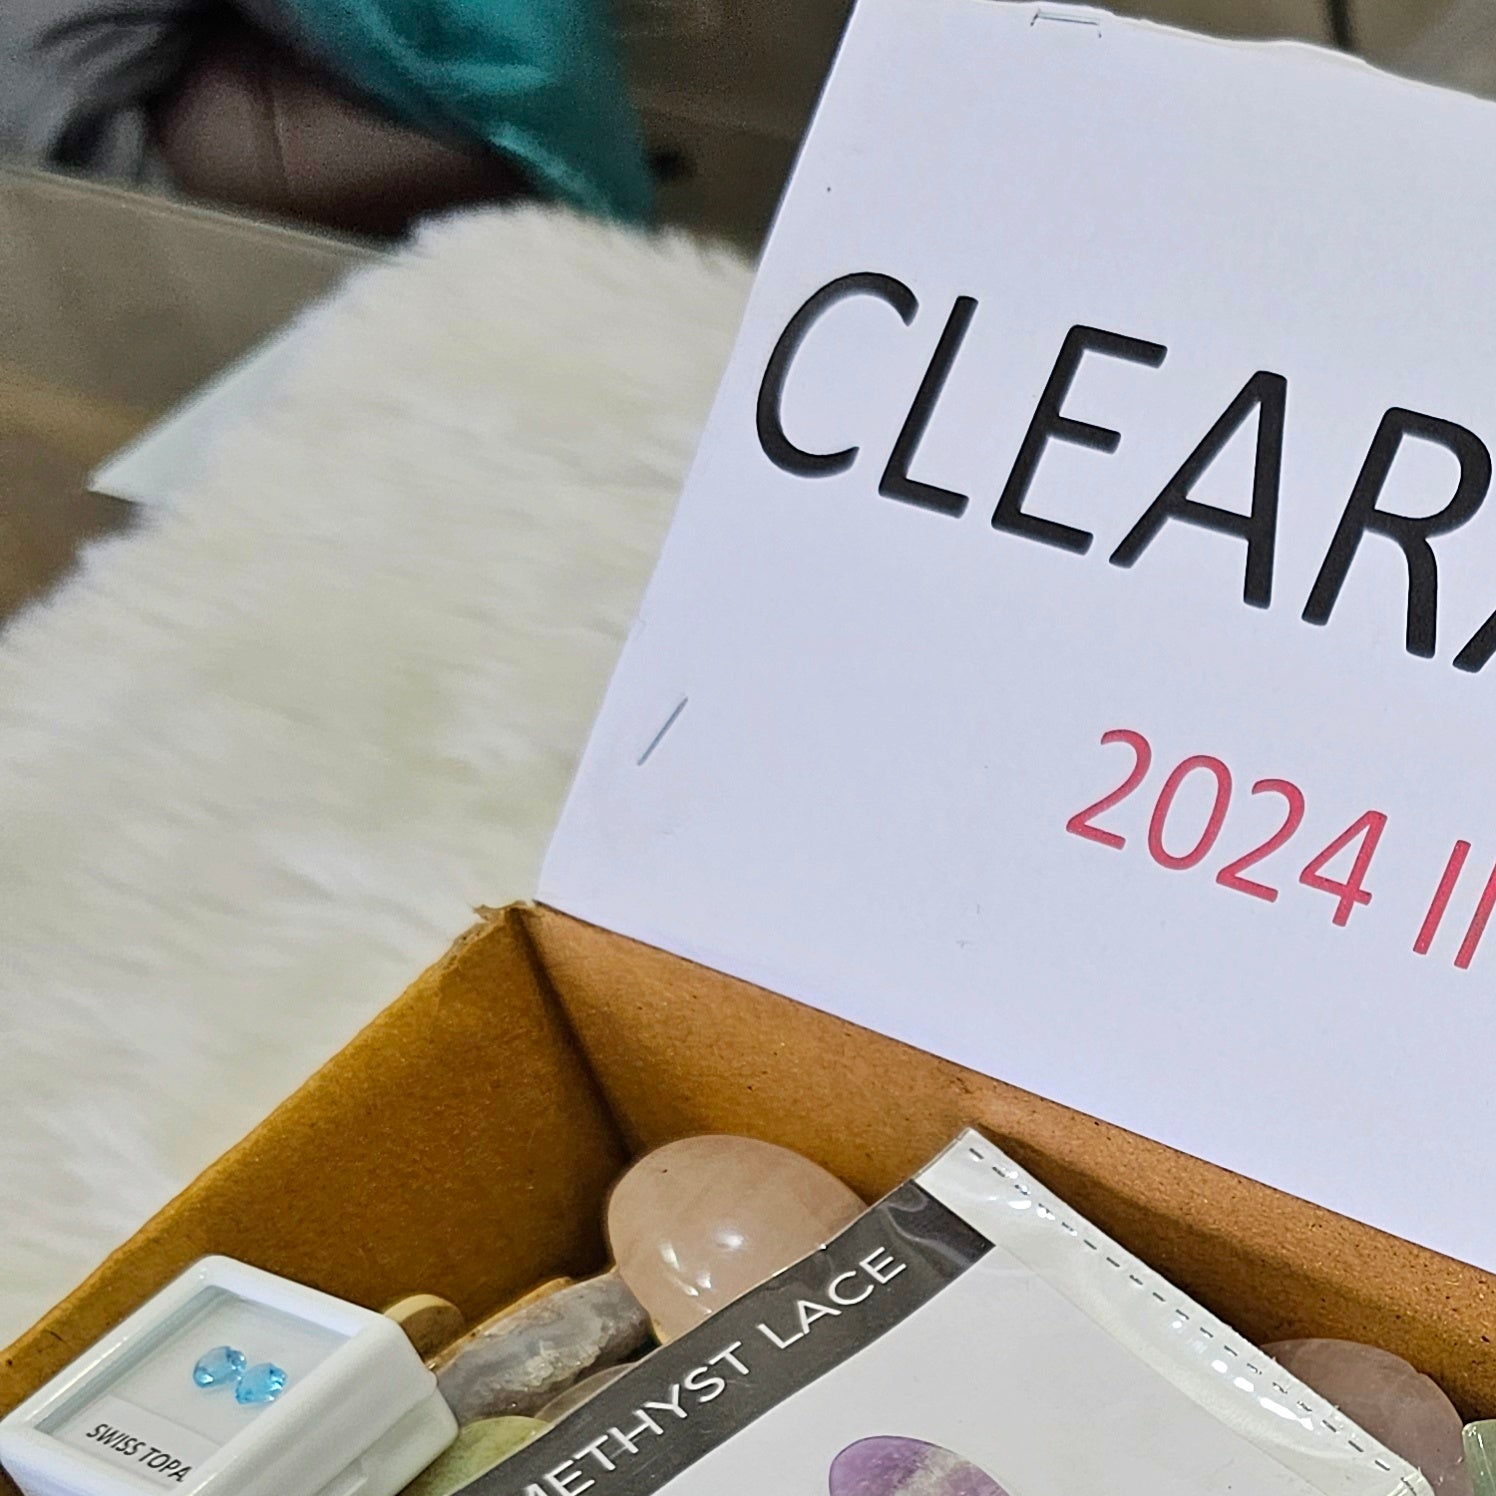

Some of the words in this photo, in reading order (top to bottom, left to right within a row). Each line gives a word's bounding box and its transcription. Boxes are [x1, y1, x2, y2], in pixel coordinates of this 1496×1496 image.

[1066, 729, 1388, 926] 2024
[757, 1246, 907, 1349] LACE
[86, 1423, 146, 1456] SWISS
[138, 1447, 193, 1482] TOPA
